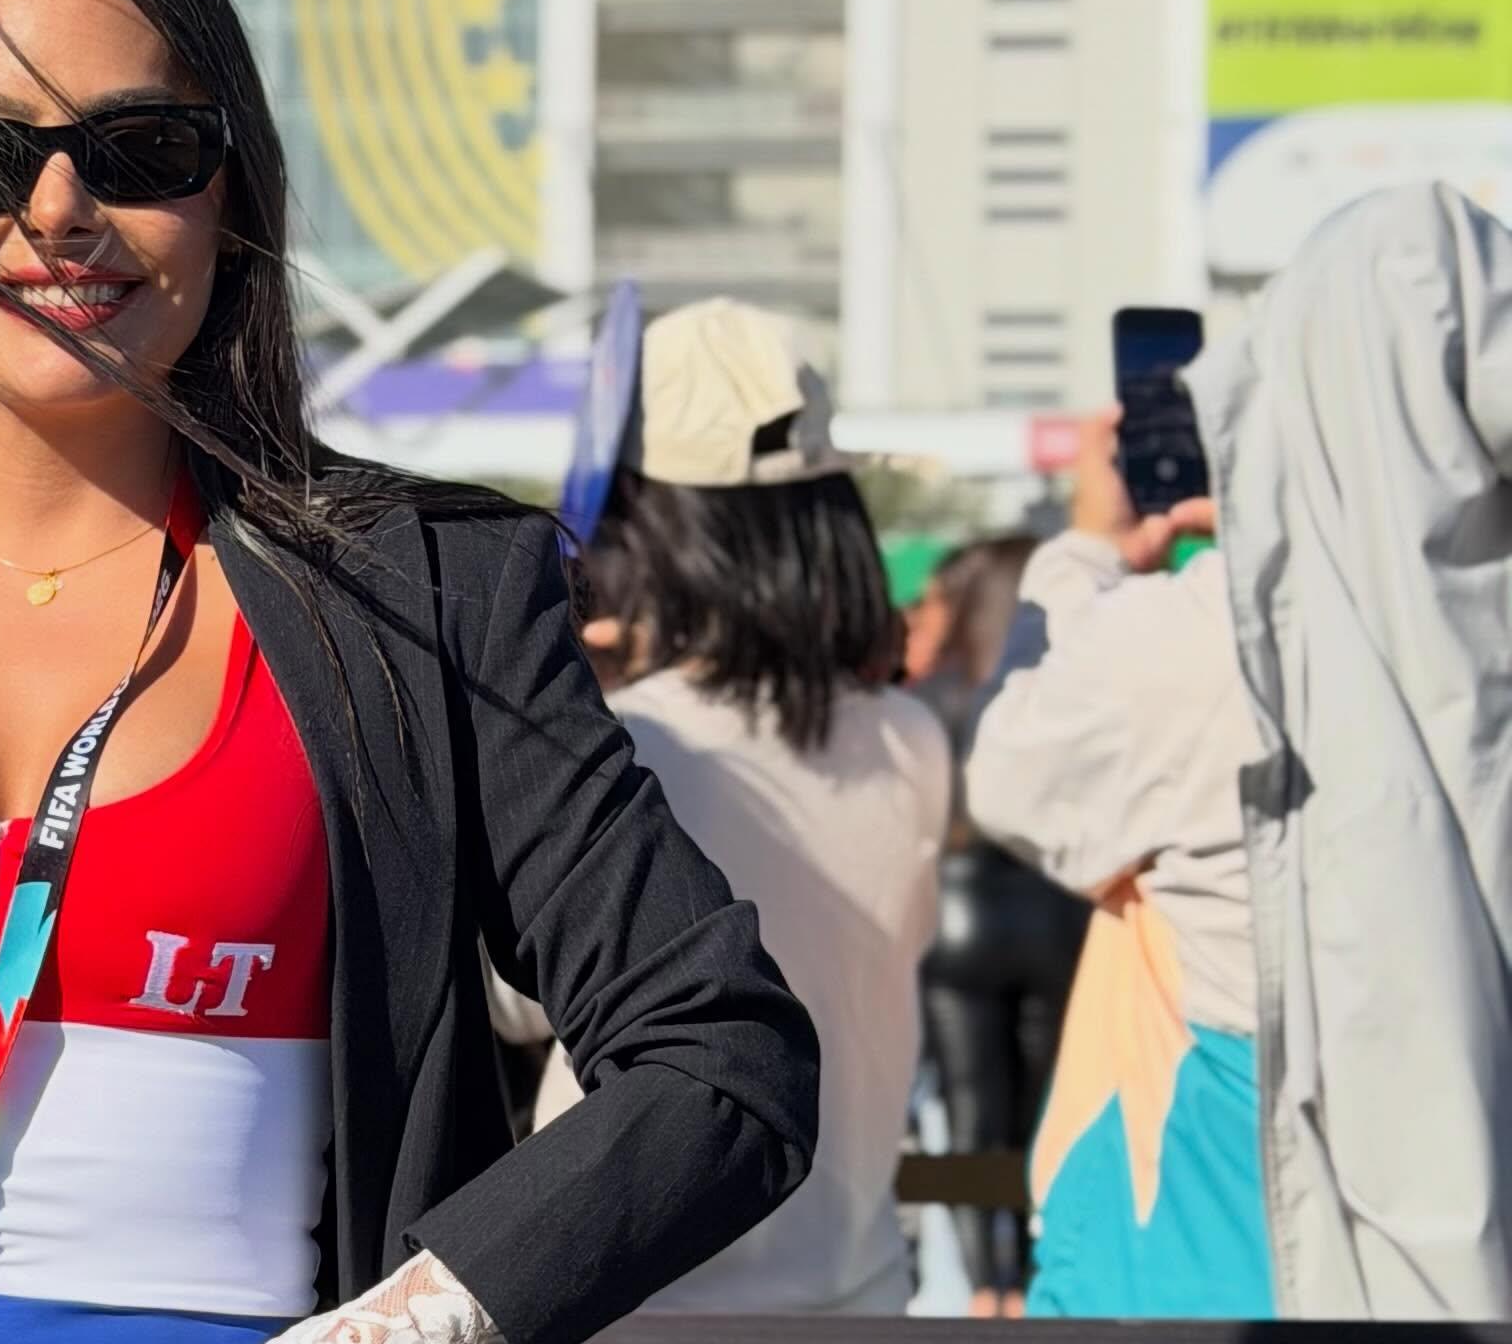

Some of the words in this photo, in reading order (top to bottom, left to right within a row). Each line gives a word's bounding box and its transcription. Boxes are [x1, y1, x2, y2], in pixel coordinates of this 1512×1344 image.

[38, 782, 83, 850] FIFA
[61, 695, 120, 778] WORLD
[129, 930, 276, 1019] LT
